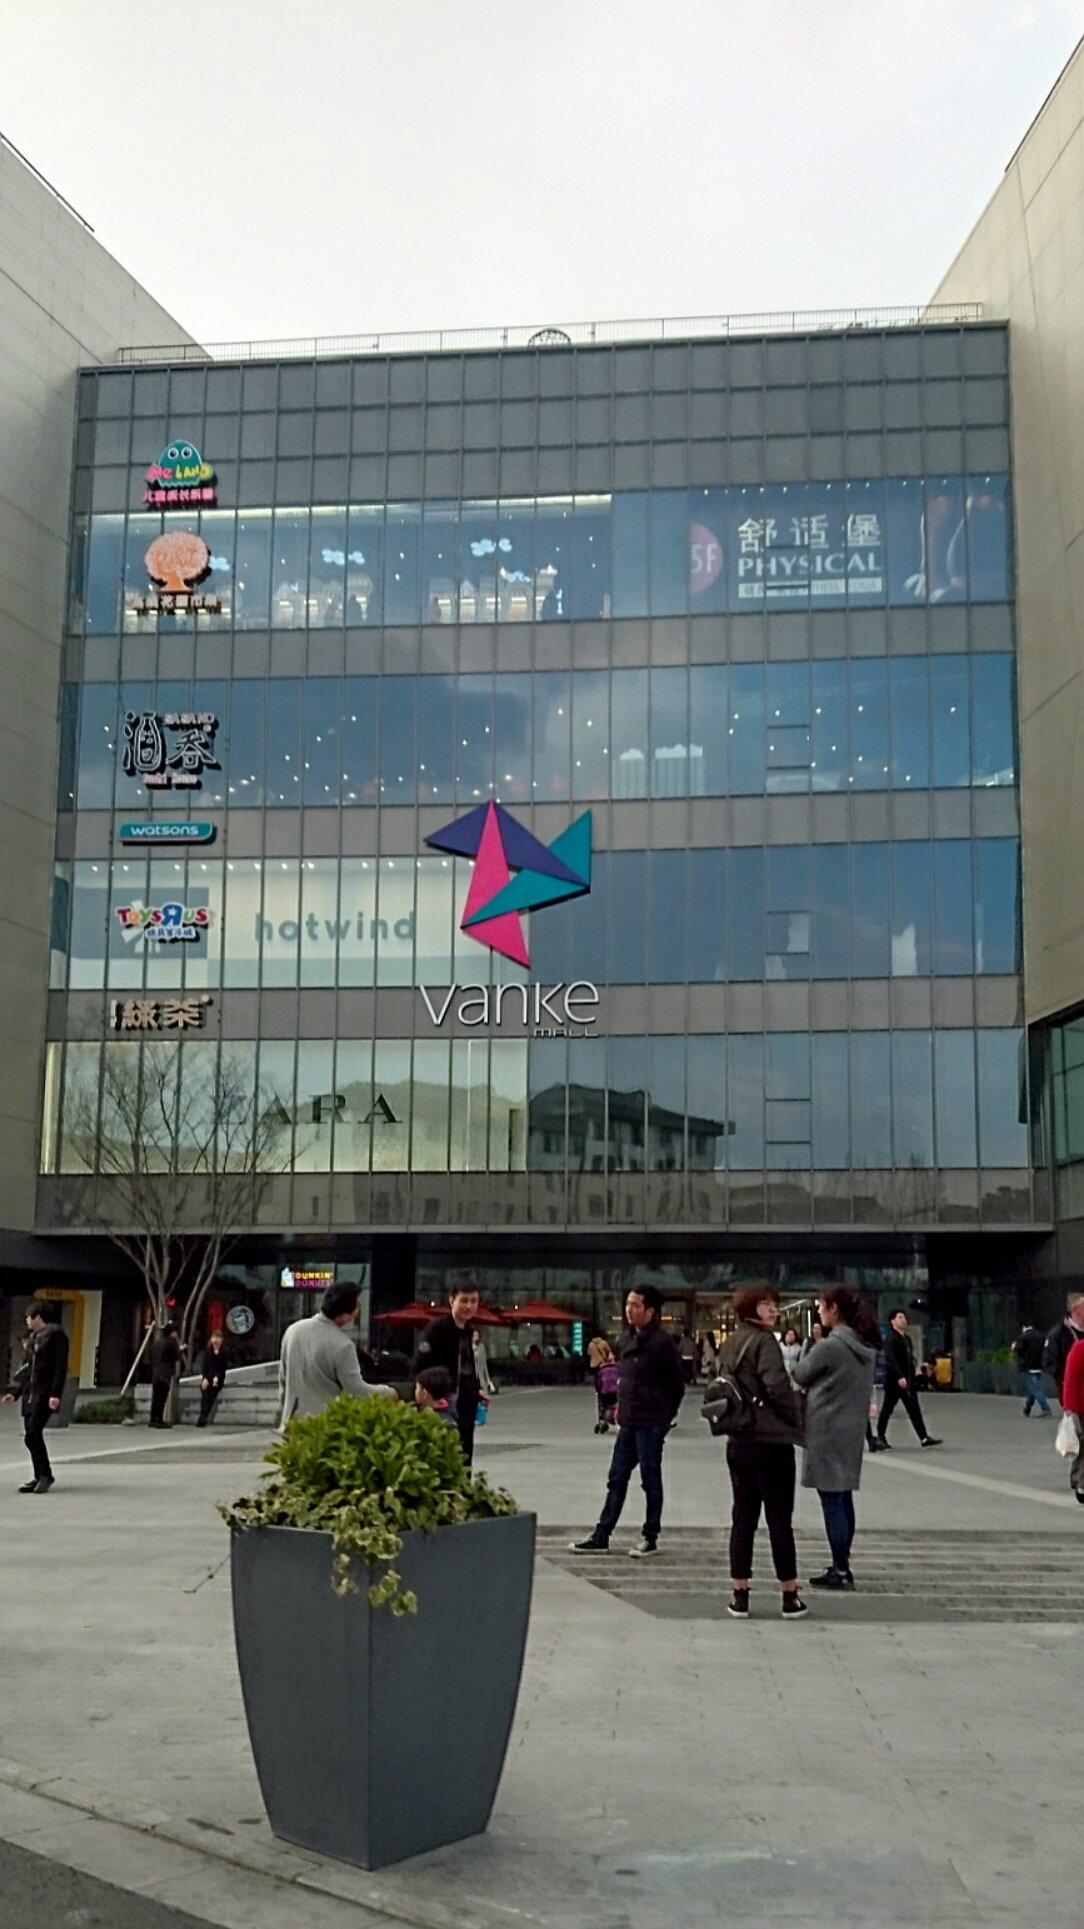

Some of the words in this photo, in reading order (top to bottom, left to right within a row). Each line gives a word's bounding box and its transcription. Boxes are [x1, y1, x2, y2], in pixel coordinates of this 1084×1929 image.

[175, 463, 214, 480] LAND
[738, 513, 881, 553] 舒适堡
[738, 552, 882, 577] PHYSICAL
[130, 825, 199, 836] watsons
[255, 911, 416, 941] hotwind
[419, 980, 600, 1027] vanke
